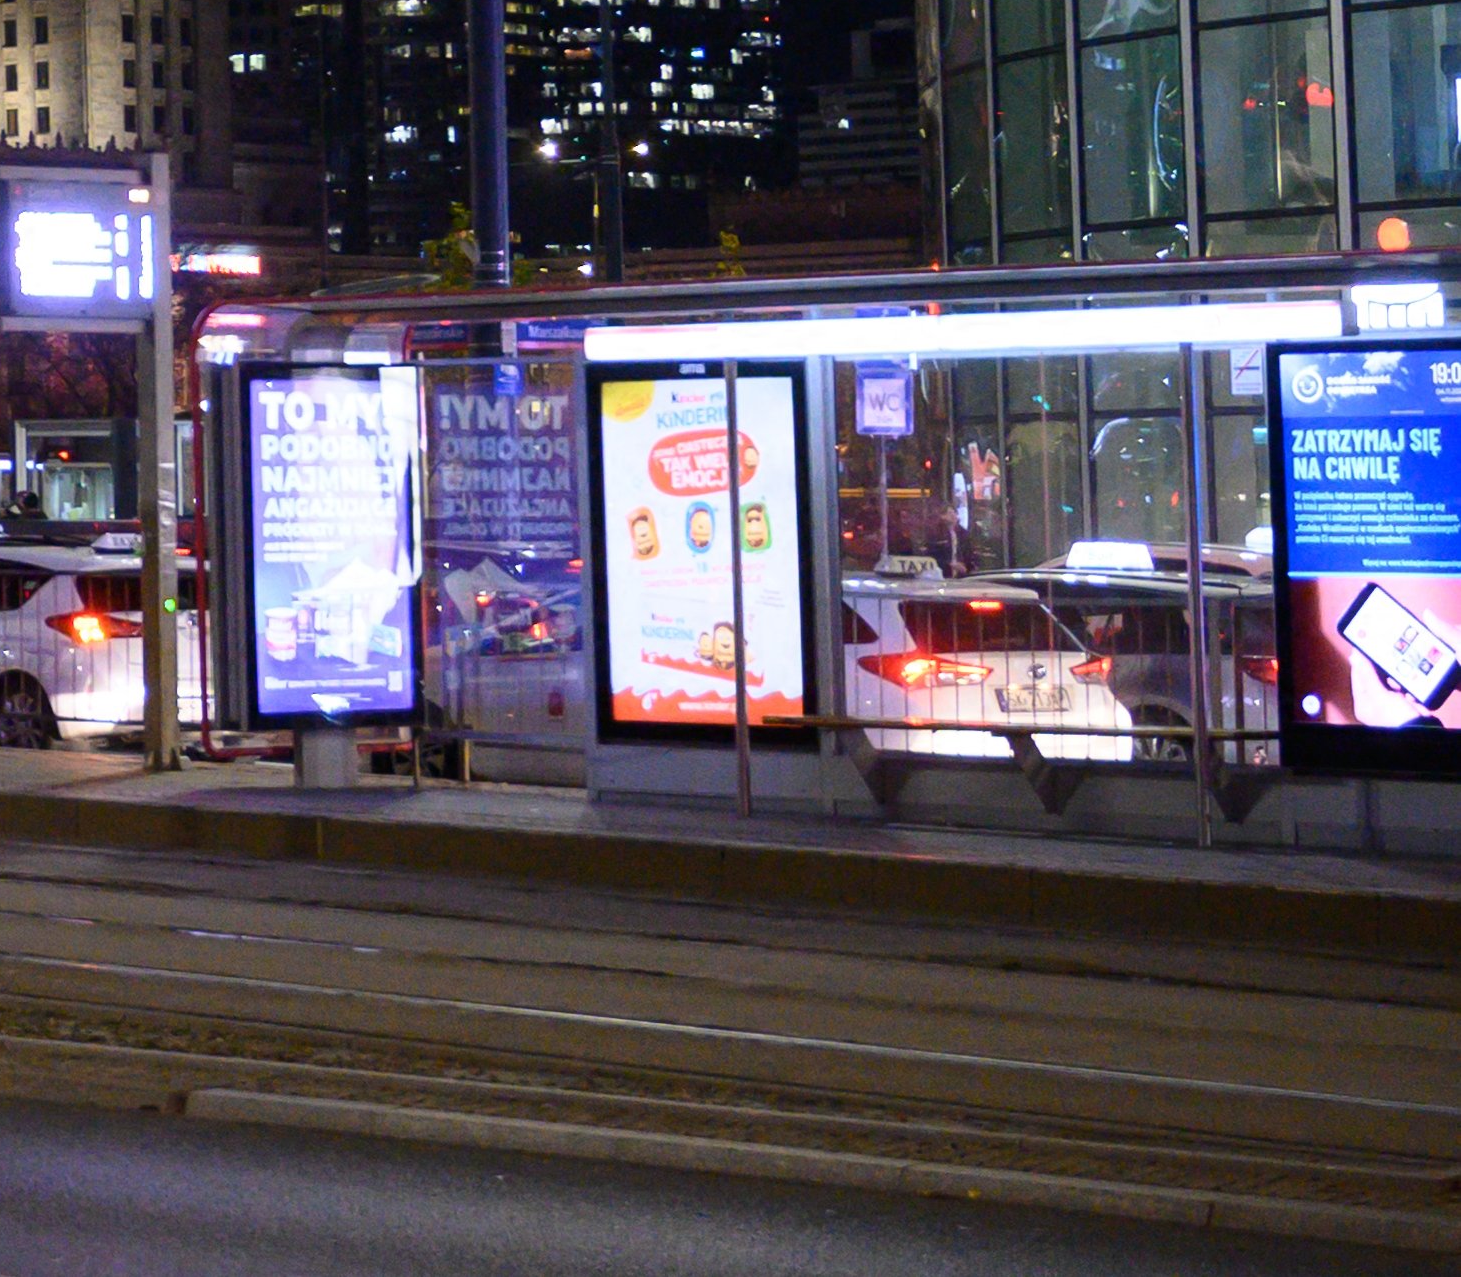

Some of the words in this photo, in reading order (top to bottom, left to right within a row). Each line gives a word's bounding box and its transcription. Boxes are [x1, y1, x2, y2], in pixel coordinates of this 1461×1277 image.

[1430, 362, 1461, 384] 19:0
[258, 391, 315, 431] TO
[868, 392, 900, 412] WC
[260, 434, 394, 461] PODOBNO
[1291, 428, 1405, 453] ZATRZYMAJ
[1409, 427, 1442, 458] SIĘ
[671, 468, 729, 489] EMOCJ
[1292, 457, 1322, 480] NA
[1325, 456, 1401, 485] CHWILĘ
[897, 560, 935, 573] TAXI
